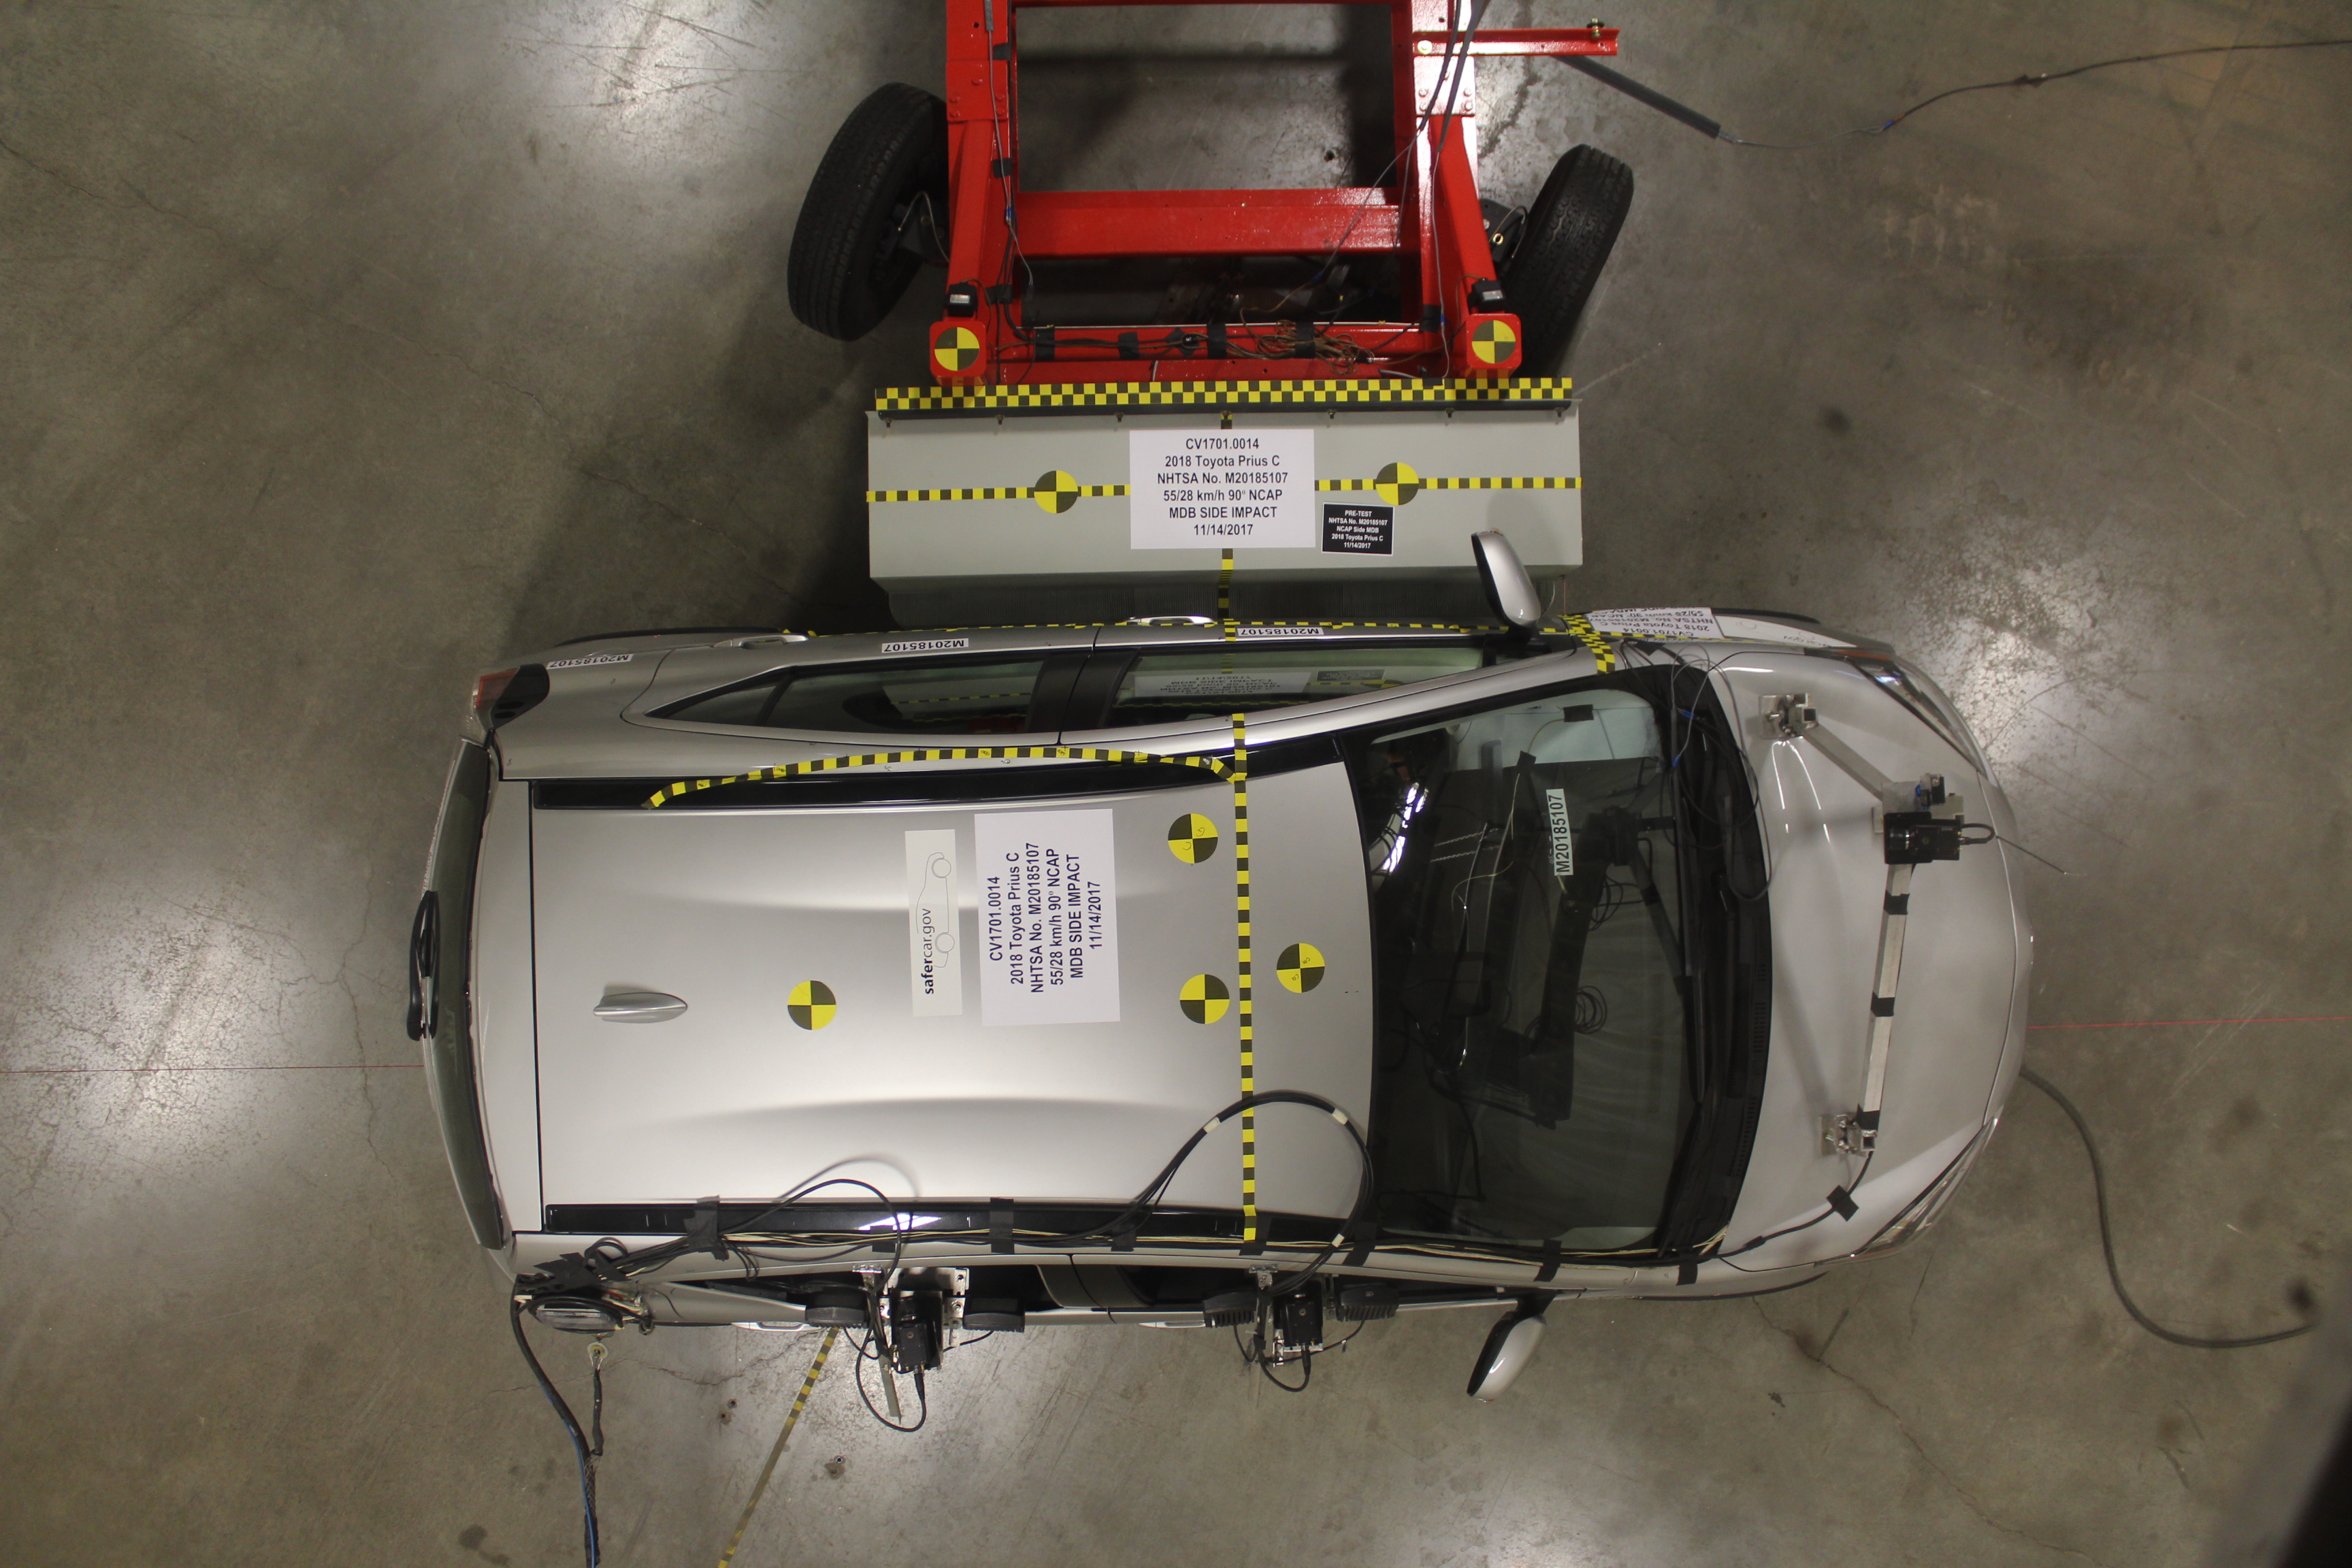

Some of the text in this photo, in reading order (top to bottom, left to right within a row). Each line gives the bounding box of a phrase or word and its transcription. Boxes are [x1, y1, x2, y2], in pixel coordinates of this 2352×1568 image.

[1186, 438, 1258, 449] CV1701.0014
[1158, 472, 1288, 483] NHTSA No. M20185107
[1166, 455, 1279, 469] 2018 Toyota Prius C
[1164, 490, 1192, 501] 55/28
[1198, 490, 1224, 500] km/h
[1250, 489, 1282, 500] NCAP
[1170, 507, 1277, 518] MDB SIDE IMPACT
[1194, 524, 1253, 535] 11/14/2017
[550, 655, 629, 667] M20185107
[884, 640, 964, 652] M20185107
[1548, 795, 1570, 872] M20185107
[1046, 849, 1060, 886] NCAP
[987, 877, 1002, 960] CV1701.0014
[1007, 853, 1025, 984] 2018 Toyota Prius C
[1026, 843, 1043, 992] NHTSA No. M20185107
[1049, 915, 1062, 946] km/h
[1066, 854, 1083, 978] MDB SIDE IMPACT
[1088, 882, 1102, 949] 11/14/2017
[921, 909, 934, 994] safercar.gov
[1050, 951, 1063, 985] 55/28
